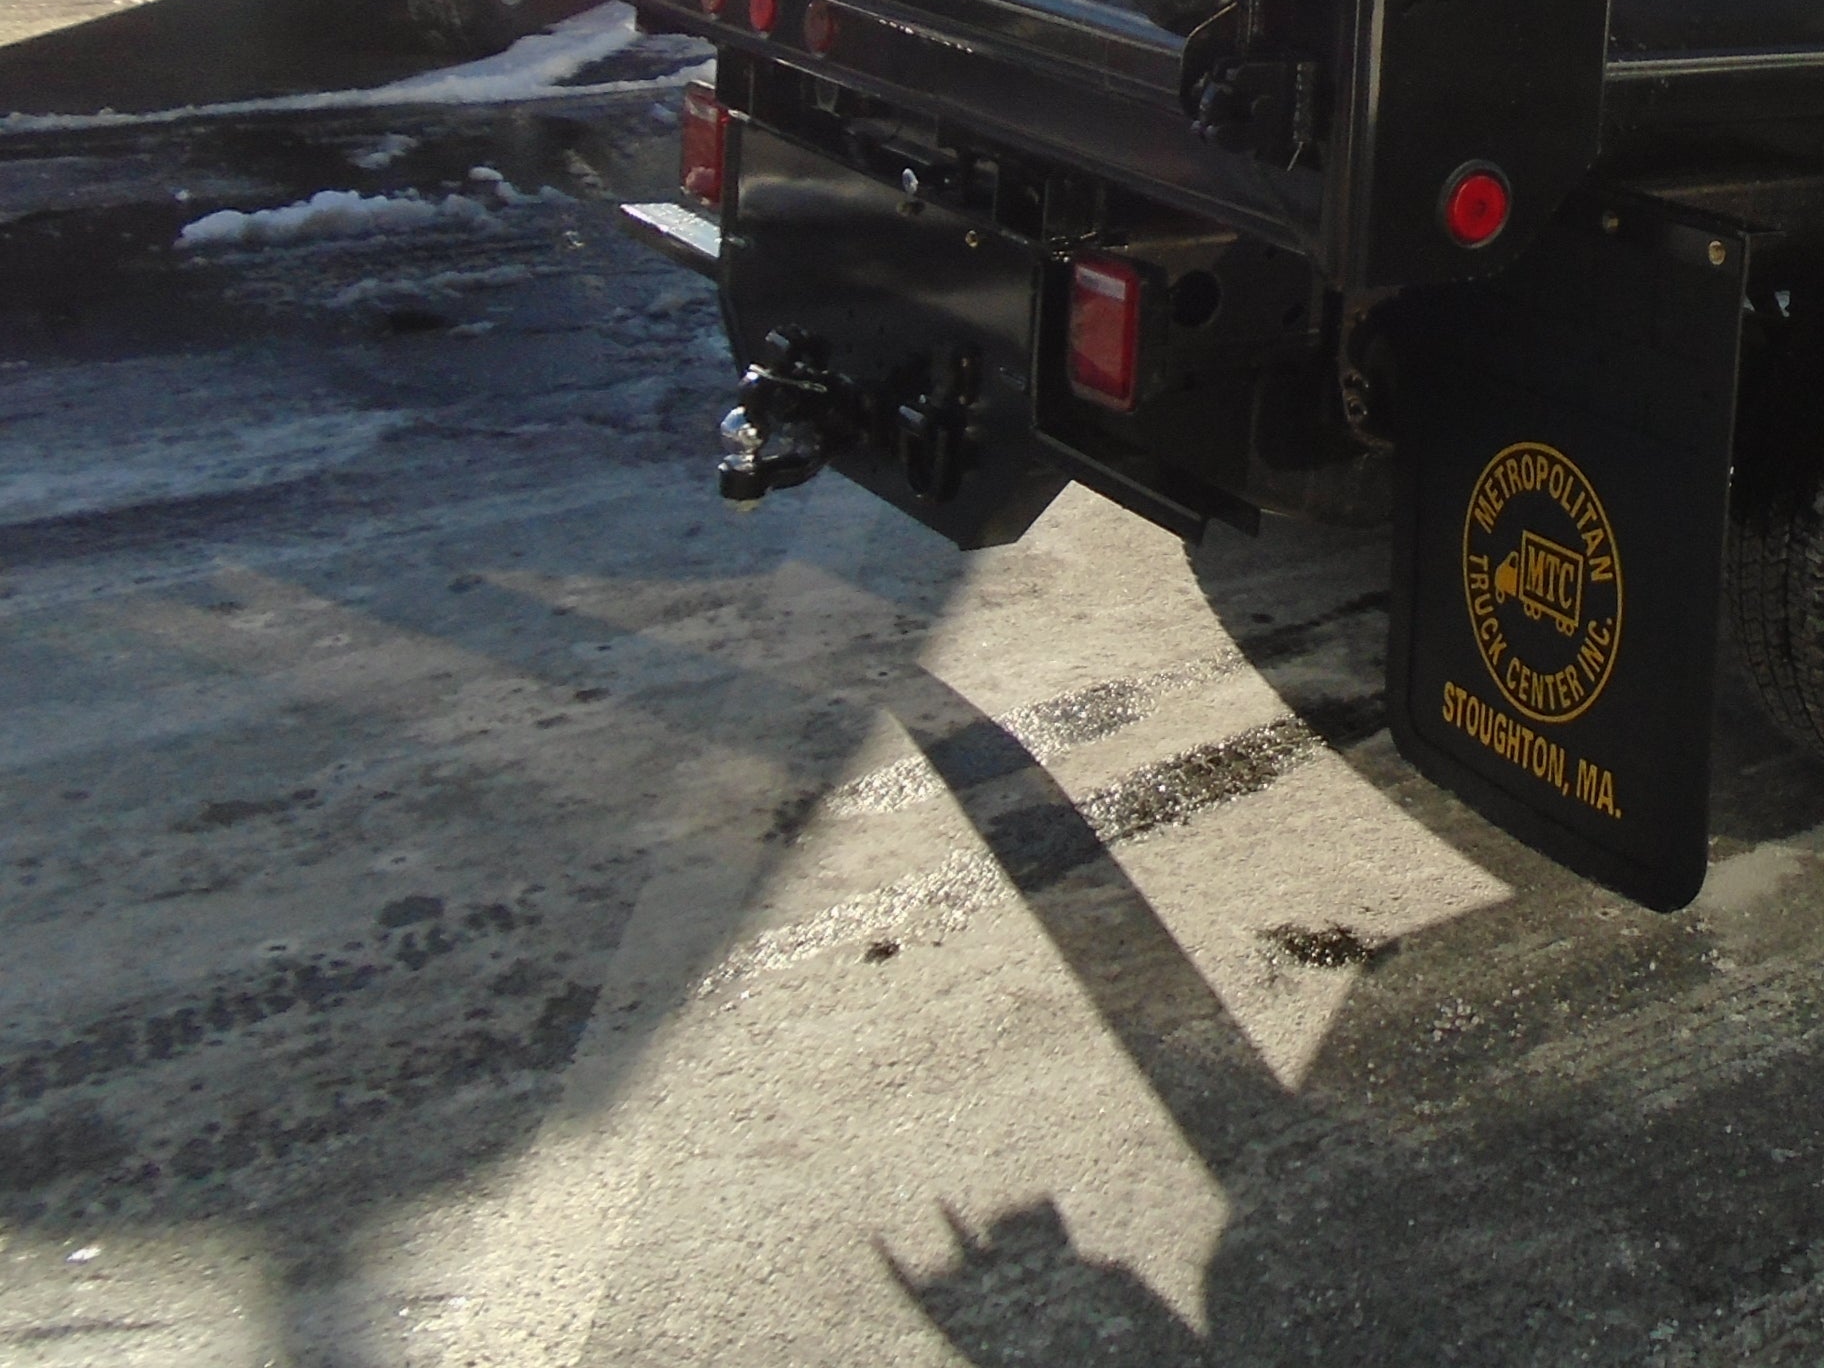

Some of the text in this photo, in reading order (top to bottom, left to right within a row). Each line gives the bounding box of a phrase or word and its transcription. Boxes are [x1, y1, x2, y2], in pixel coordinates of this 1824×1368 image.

[1475, 452, 1613, 584] METROPOLITAN
[1525, 545, 1577, 610] MTC
[1468, 553, 1614, 711] TRUCK CENTER INC.
[1441, 680, 1624, 819] STOUGHTON, MA.
